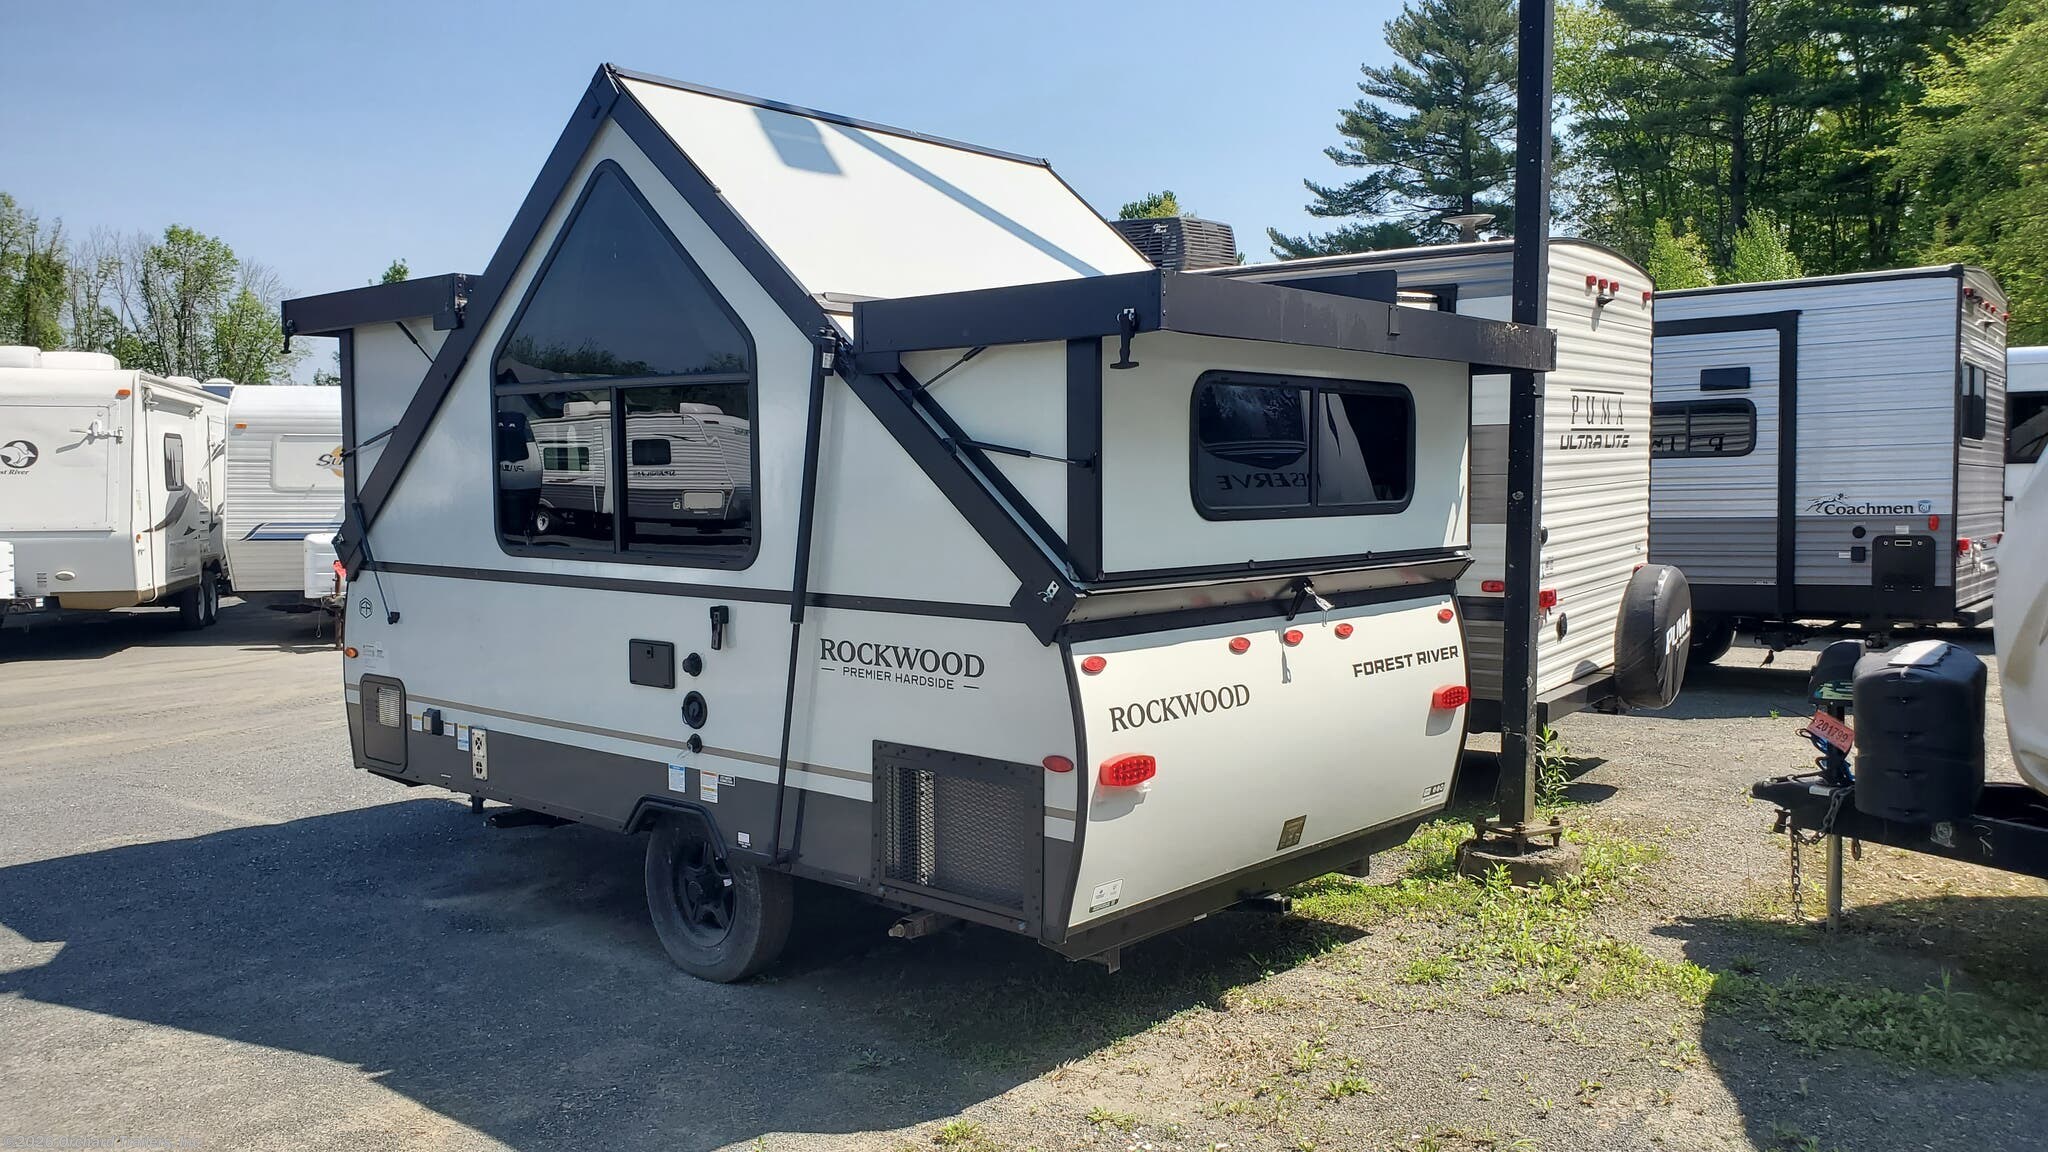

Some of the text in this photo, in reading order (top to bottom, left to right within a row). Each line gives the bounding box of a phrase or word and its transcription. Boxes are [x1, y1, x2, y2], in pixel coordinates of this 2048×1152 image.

[1570, 395, 1624, 425] PUMA
[1559, 434, 1631, 450] ULTRA LITE
[1823, 502, 1915, 516] Coachmen
[1665, 607, 1691, 656] PUMA
[820, 638, 985, 679] ROCKWOOD
[1352, 645, 1460, 678] FOREST RIVER
[842, 666, 955, 690] PREMIER HARDSIDE
[1108, 683, 1251, 733] ROCKWOOD
